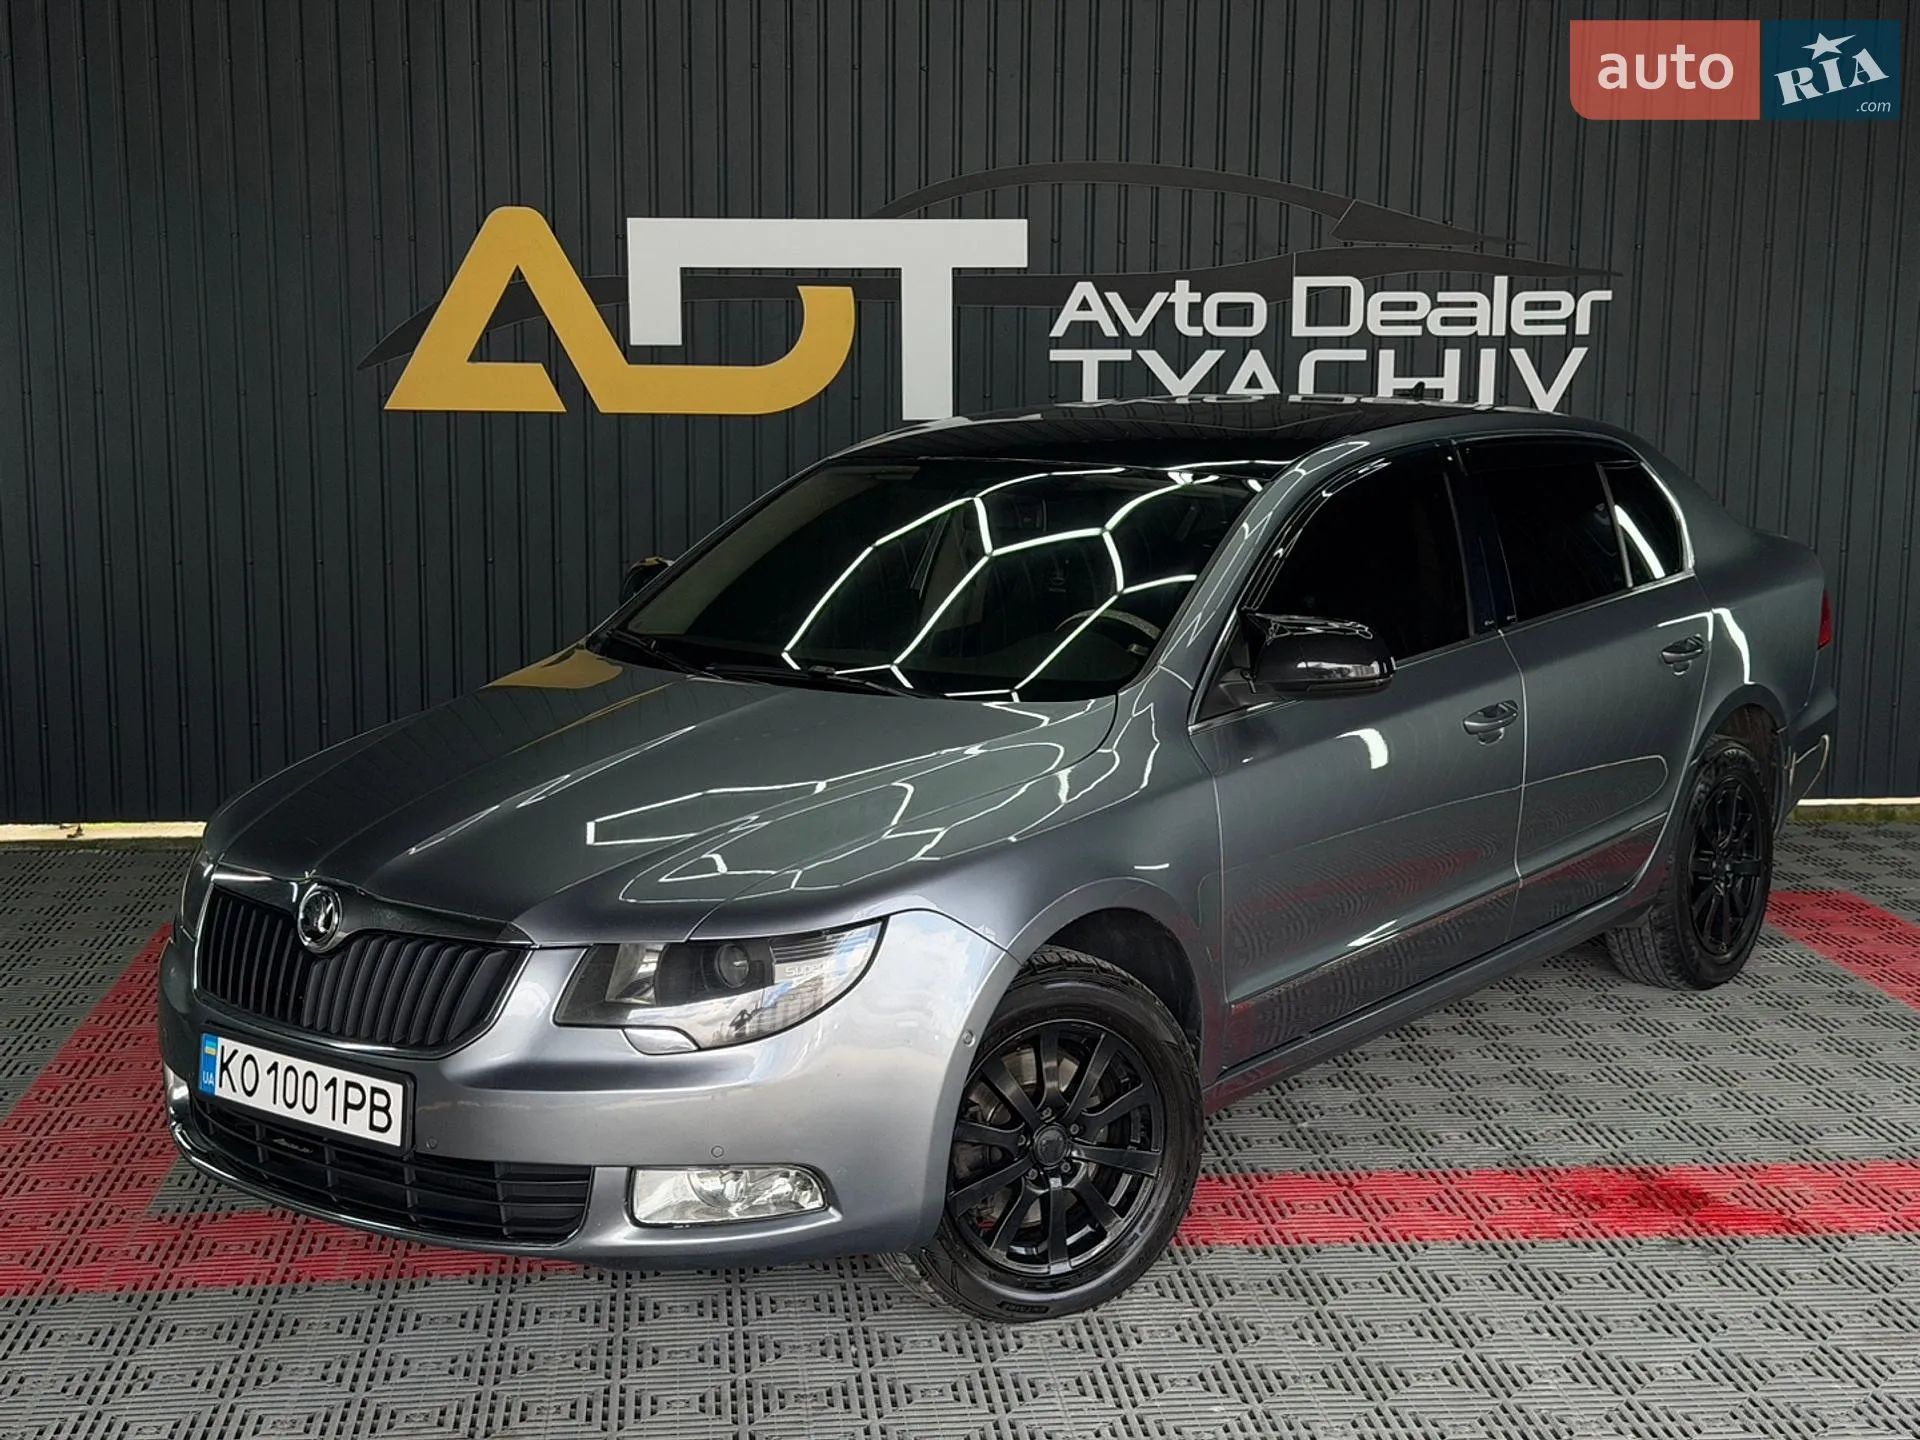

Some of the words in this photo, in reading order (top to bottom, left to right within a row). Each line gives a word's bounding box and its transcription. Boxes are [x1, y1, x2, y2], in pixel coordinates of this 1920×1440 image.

[384, 206, 1029, 421] ADT
[1048, 280, 1269, 338] Avto
[1291, 275, 1613, 338] Dealer
[1048, 347, 1589, 412] TYACHIV
[202, 1070, 215, 1087] UA
